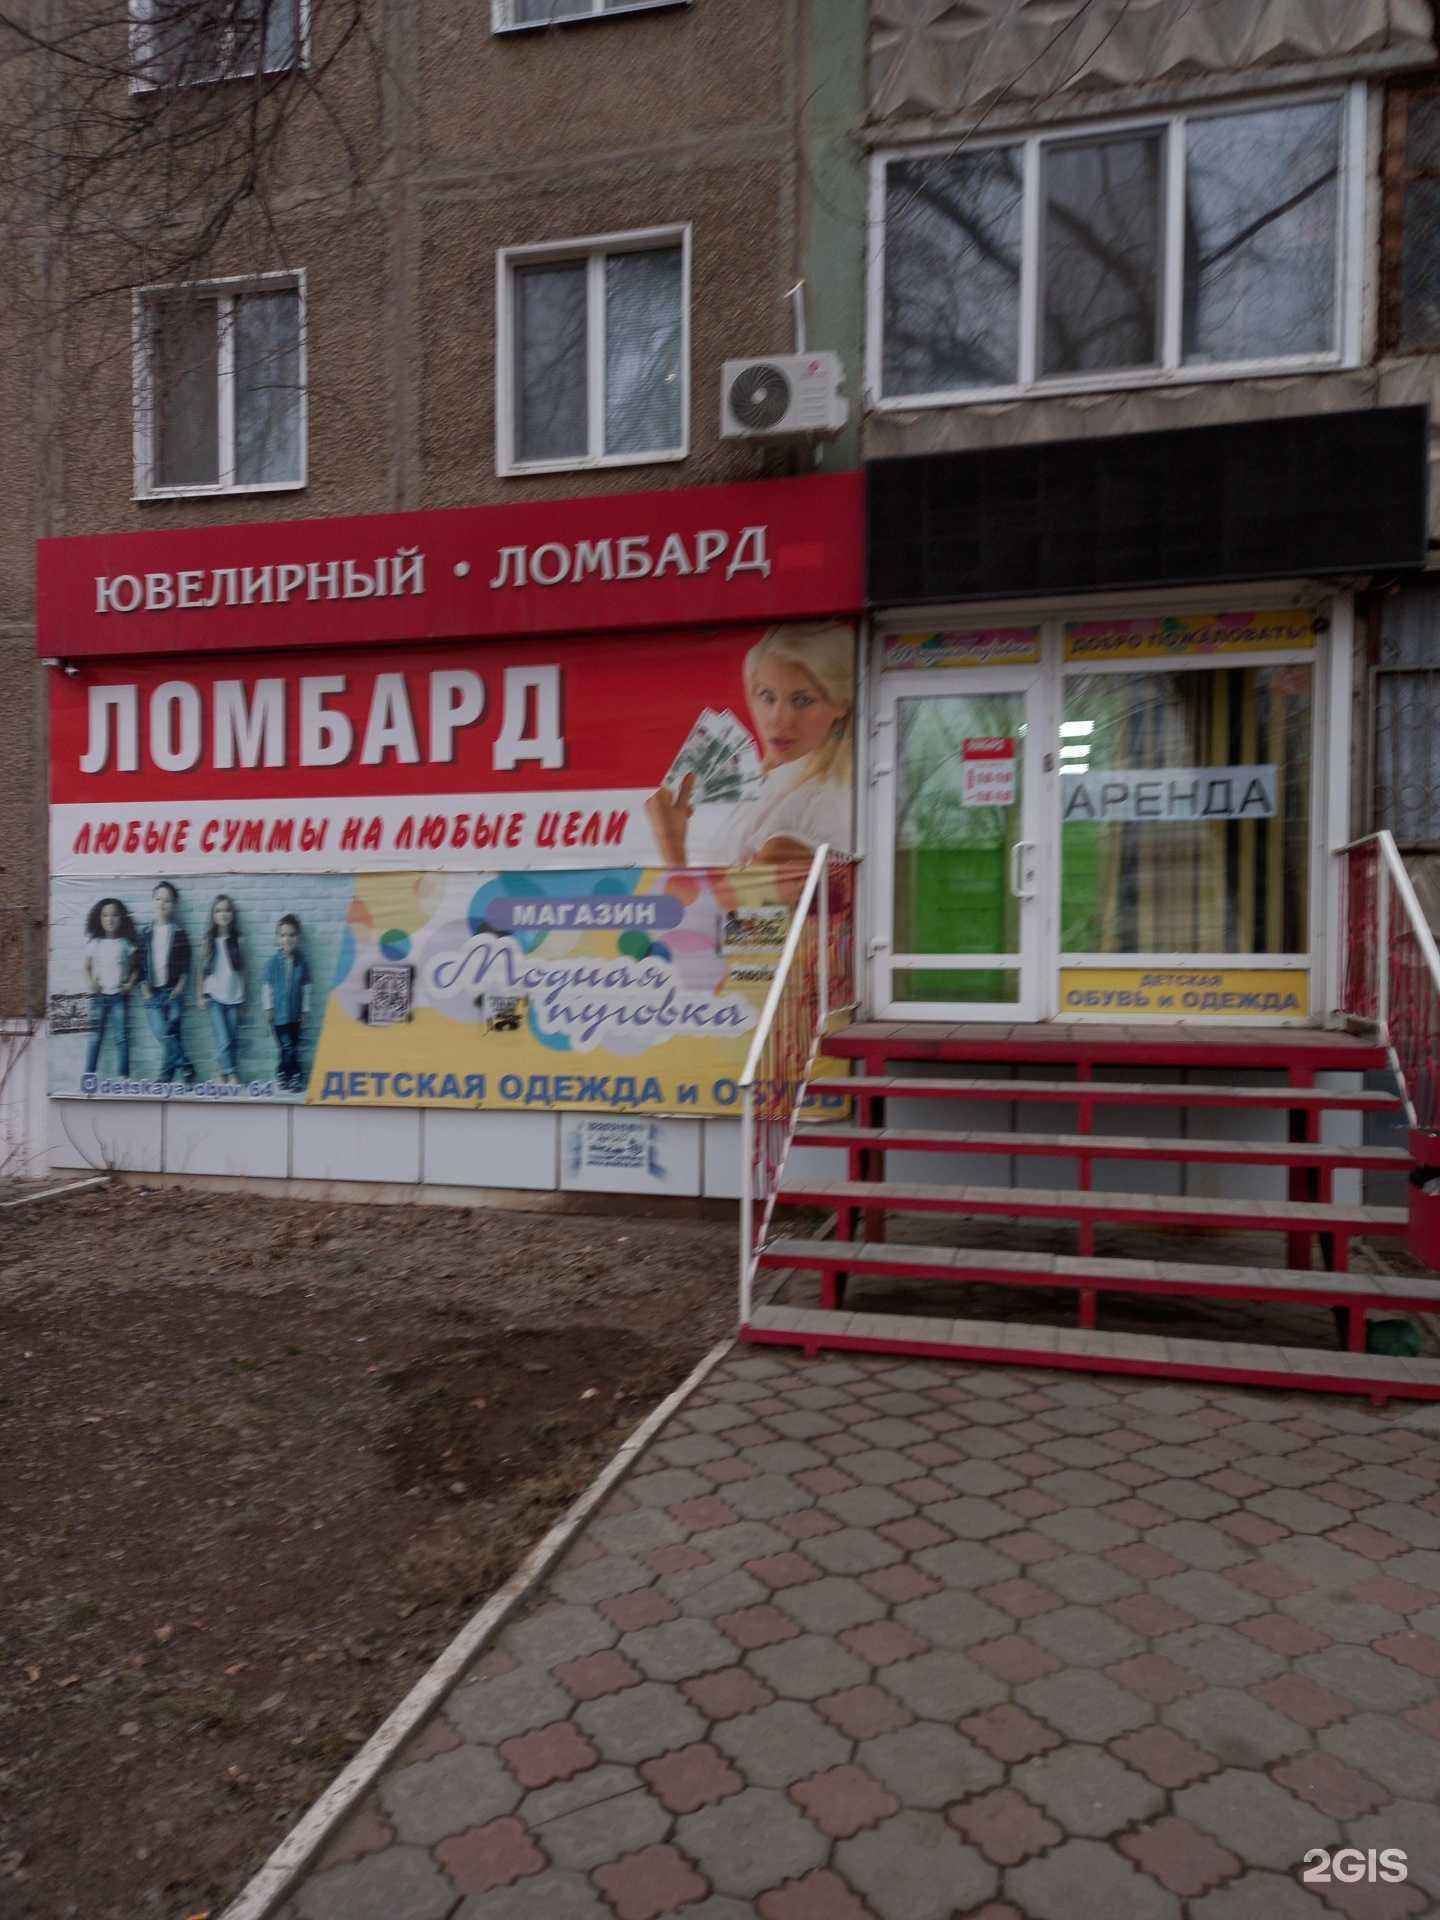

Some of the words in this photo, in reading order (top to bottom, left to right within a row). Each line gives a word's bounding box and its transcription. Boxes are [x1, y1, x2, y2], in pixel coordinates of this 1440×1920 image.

[95, 545, 426, 613] ЮВЕЛИРНЫЙ
[490, 525, 771, 589] ЛОМБАРД
[79, 664, 565, 774] ЛОМБАРД
[1064, 778, 1271, 817] АРЕНДА
[73, 819, 190, 854] ЛЮБЫЕ
[200, 818, 328, 853] СУММЫ
[339, 815, 384, 851] НА
[394, 812, 525, 850] ЛЮБЫЕ
[536, 809, 629, 849] ЦЕЛИ
[512, 902, 656, 926] МАГАЗИН
[435, 943, 671, 1004] Модная
[546, 987, 749, 1042] пуговка
[1067, 989, 1150, 1006] ОБУВЬ
[1182, 991, 1298, 1012] ОДЕЖДА
[321, 1071, 487, 1100] ДЕТСКАЯ
[498, 1073, 664, 1106] ОДЕЖДА
[677, 1084, 697, 1104] и
